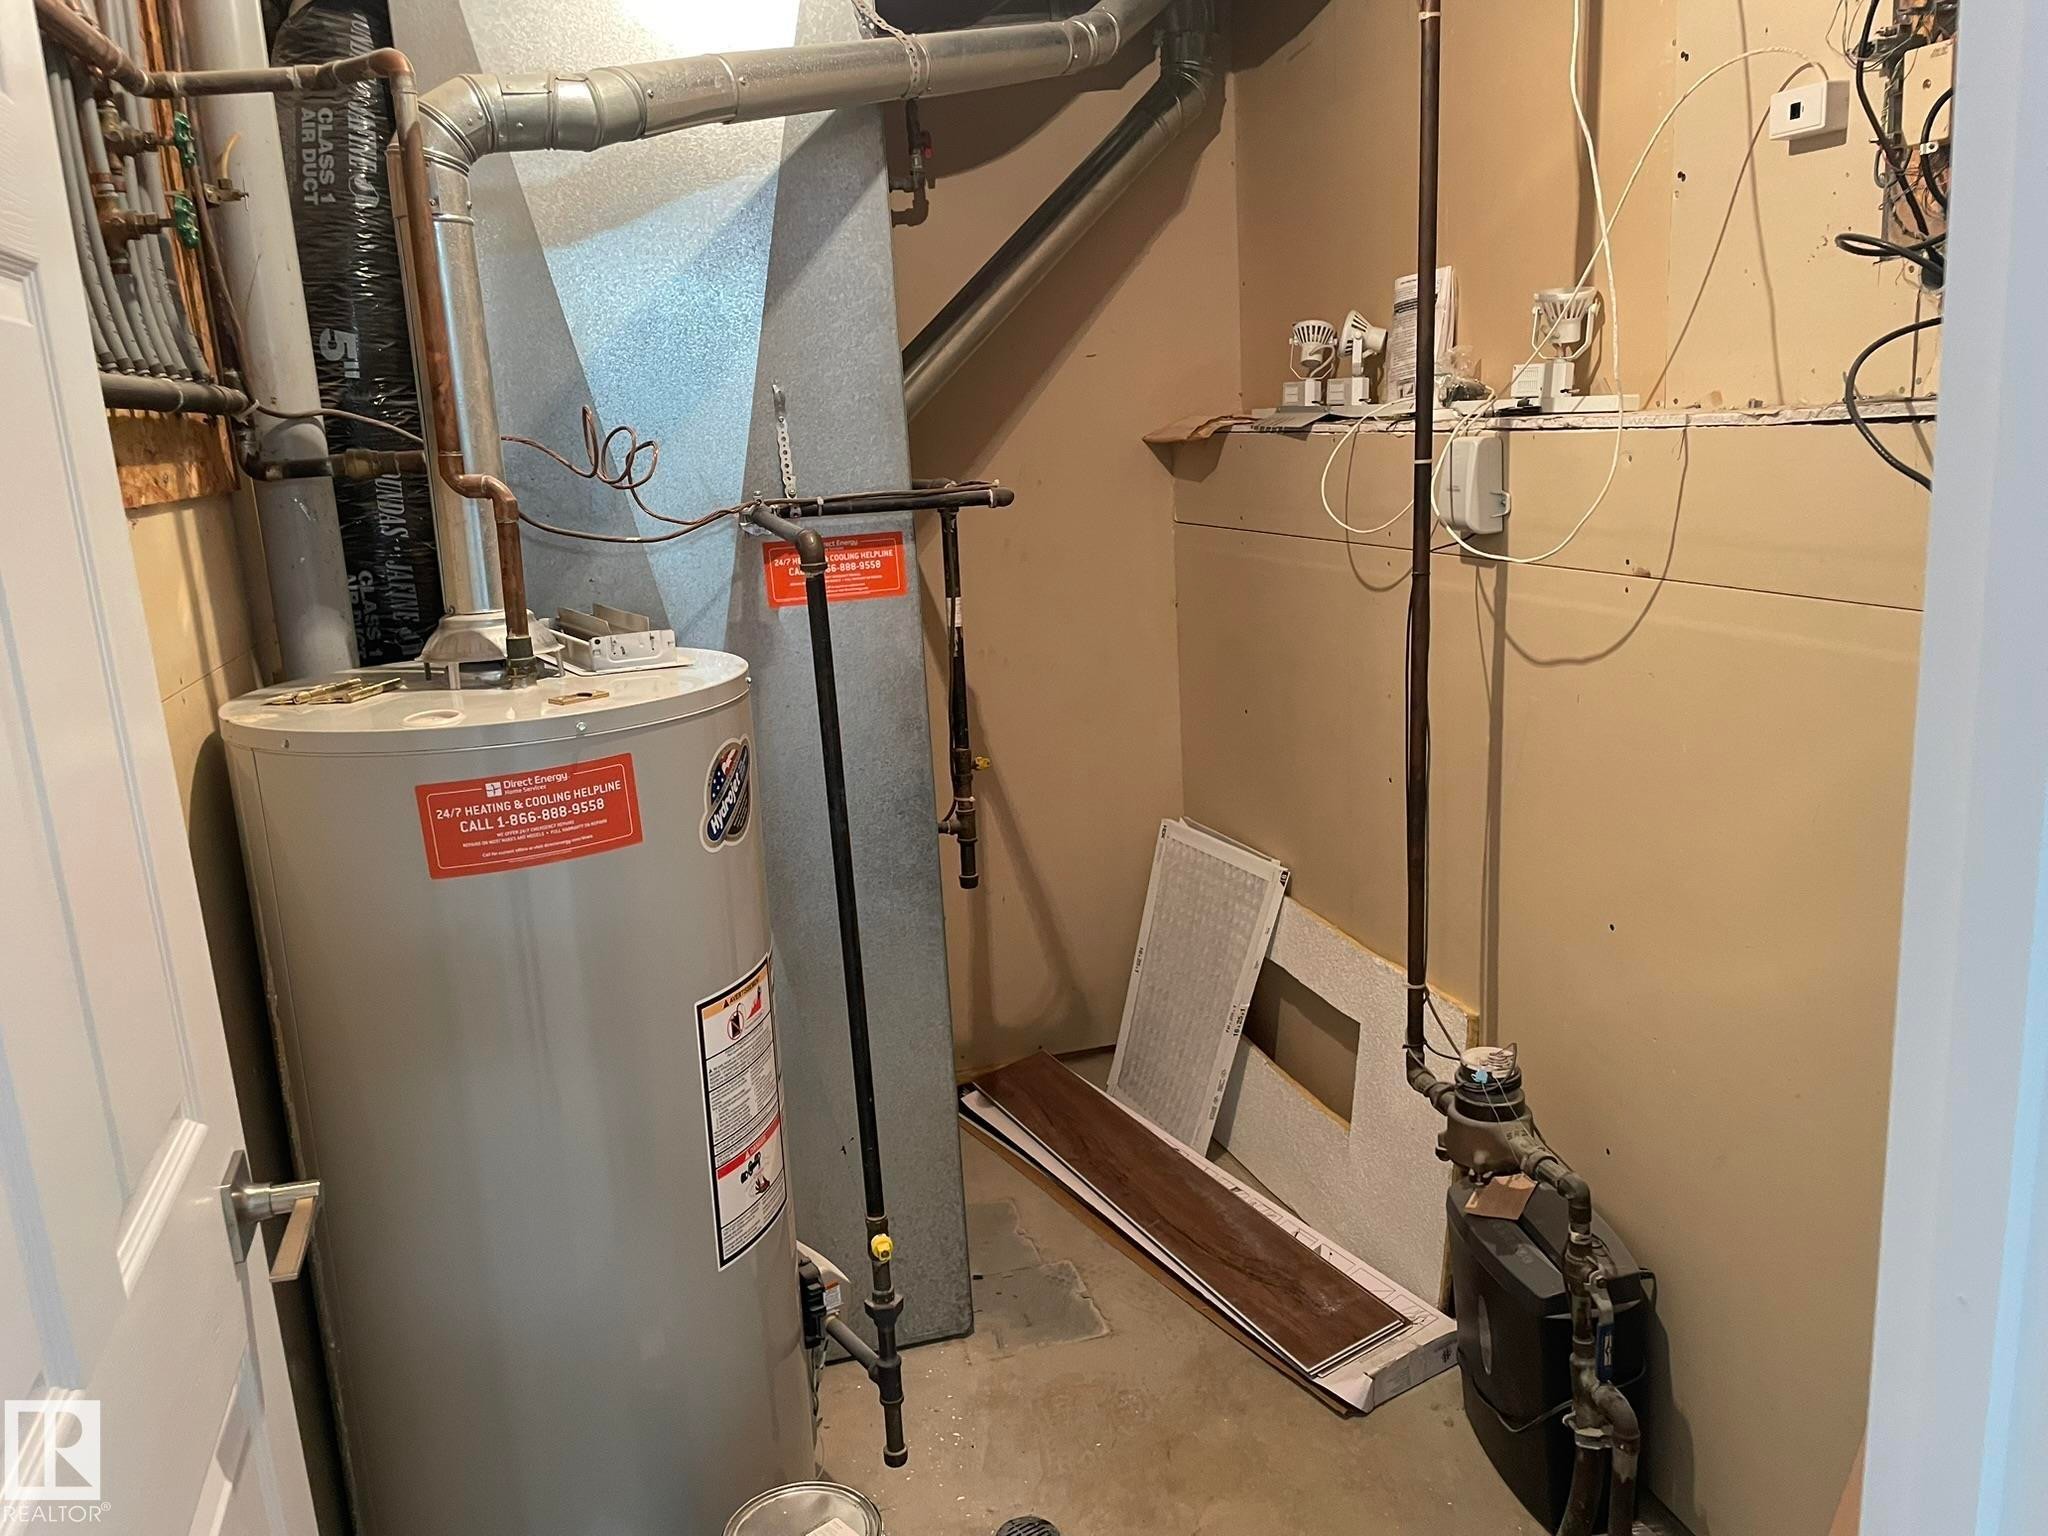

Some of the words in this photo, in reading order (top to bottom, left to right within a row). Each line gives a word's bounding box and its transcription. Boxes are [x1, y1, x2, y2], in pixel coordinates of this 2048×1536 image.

[301, 108, 317, 143] AIR
[317, 107, 336, 185] CLASS
[302, 149, 319, 206] DUCT
[320, 193, 336, 204] 1
[830, 552, 860, 562] COOLING
[861, 550, 893, 561] HELPLINE
[358, 570, 383, 641] CLASS
[385, 560, 420, 622] JAFINE
[503, 777, 533, 789] Direct
[535, 772, 568, 784] Energy
[504, 788, 522, 796] Home
[436, 807, 461, 820] 24/7
[465, 801, 511, 816] HEATING
[514, 799, 524, 810] &
[525, 792, 571, 808] COOLING
[573, 780, 621, 799] HELPLINE
[460, 818, 494, 833] CALL
[497, 798, 605, 828] 1-866-888-9558
[710, 772, 740, 834] Hydrojet
